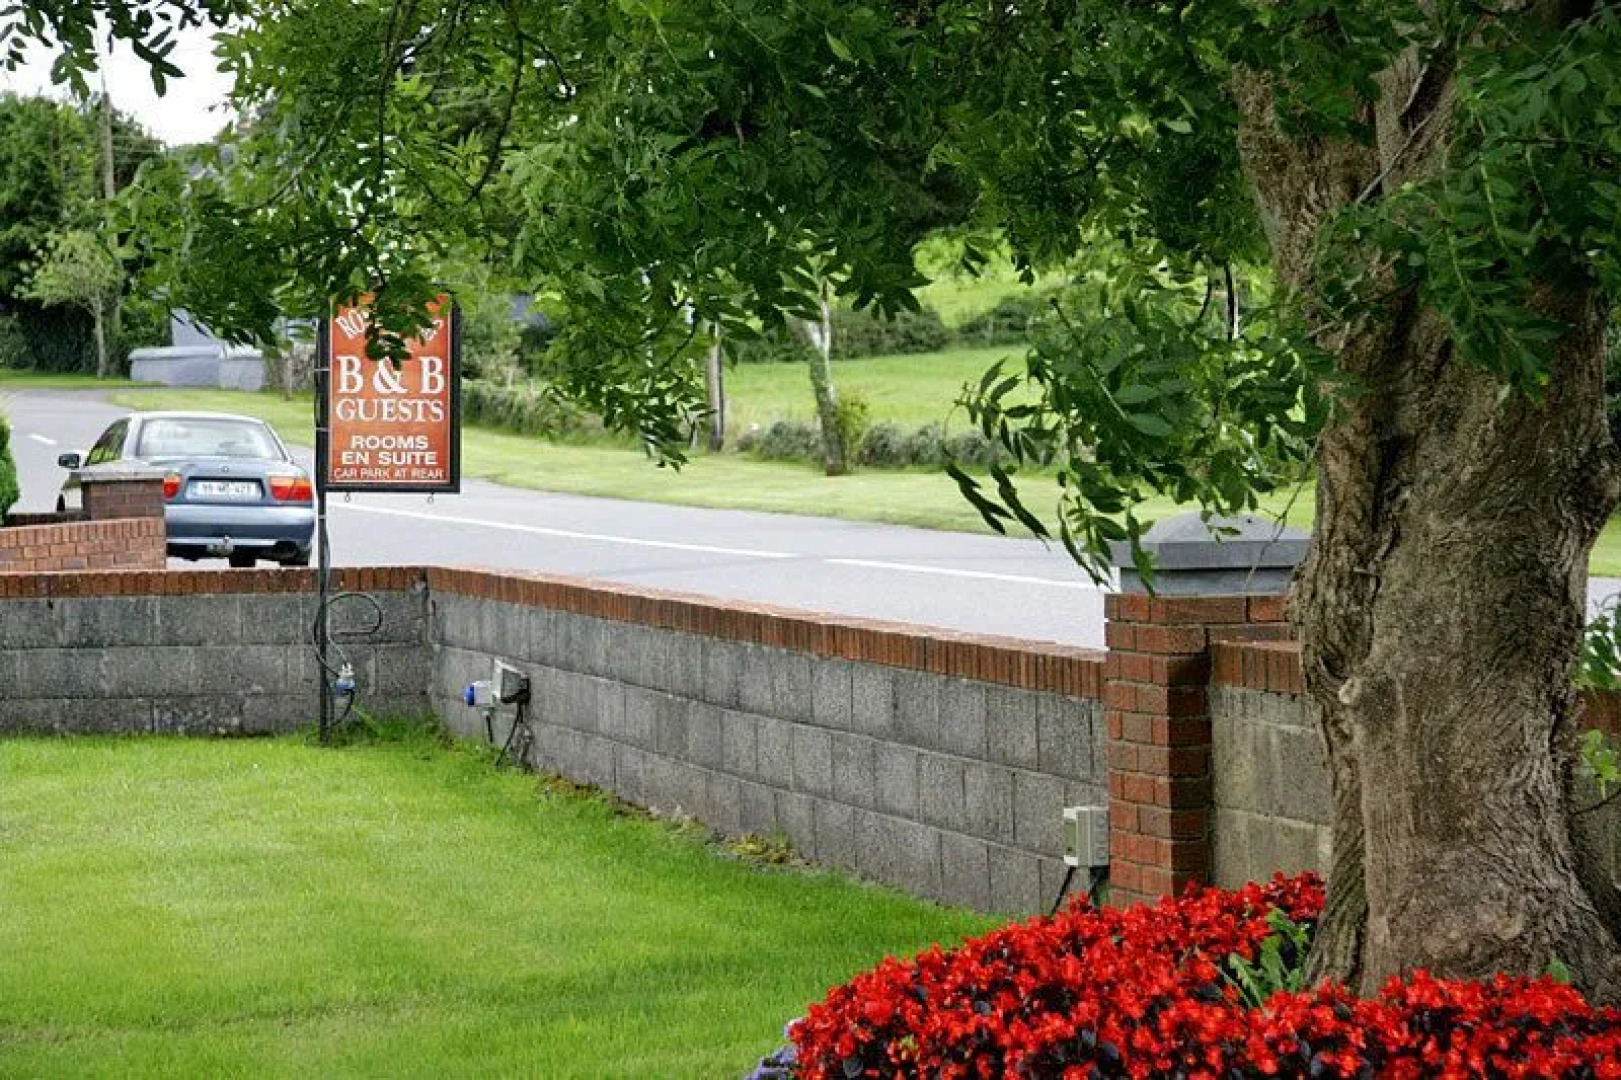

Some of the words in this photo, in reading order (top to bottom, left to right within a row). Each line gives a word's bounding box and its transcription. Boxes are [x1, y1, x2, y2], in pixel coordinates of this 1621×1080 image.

[336, 355, 364, 394] B
[372, 355, 409, 394] &
[418, 355, 445, 394] B
[335, 398, 445, 422] GUESTS
[350, 435, 429, 449] ROOMS
[341, 451, 370, 465] EN
[378, 451, 439, 465] SUITE
[333, 467, 358, 479] CAR
[360, 467, 390, 479] PARK
[394, 467, 407, 479] AT
[411, 467, 445, 479] REAR
